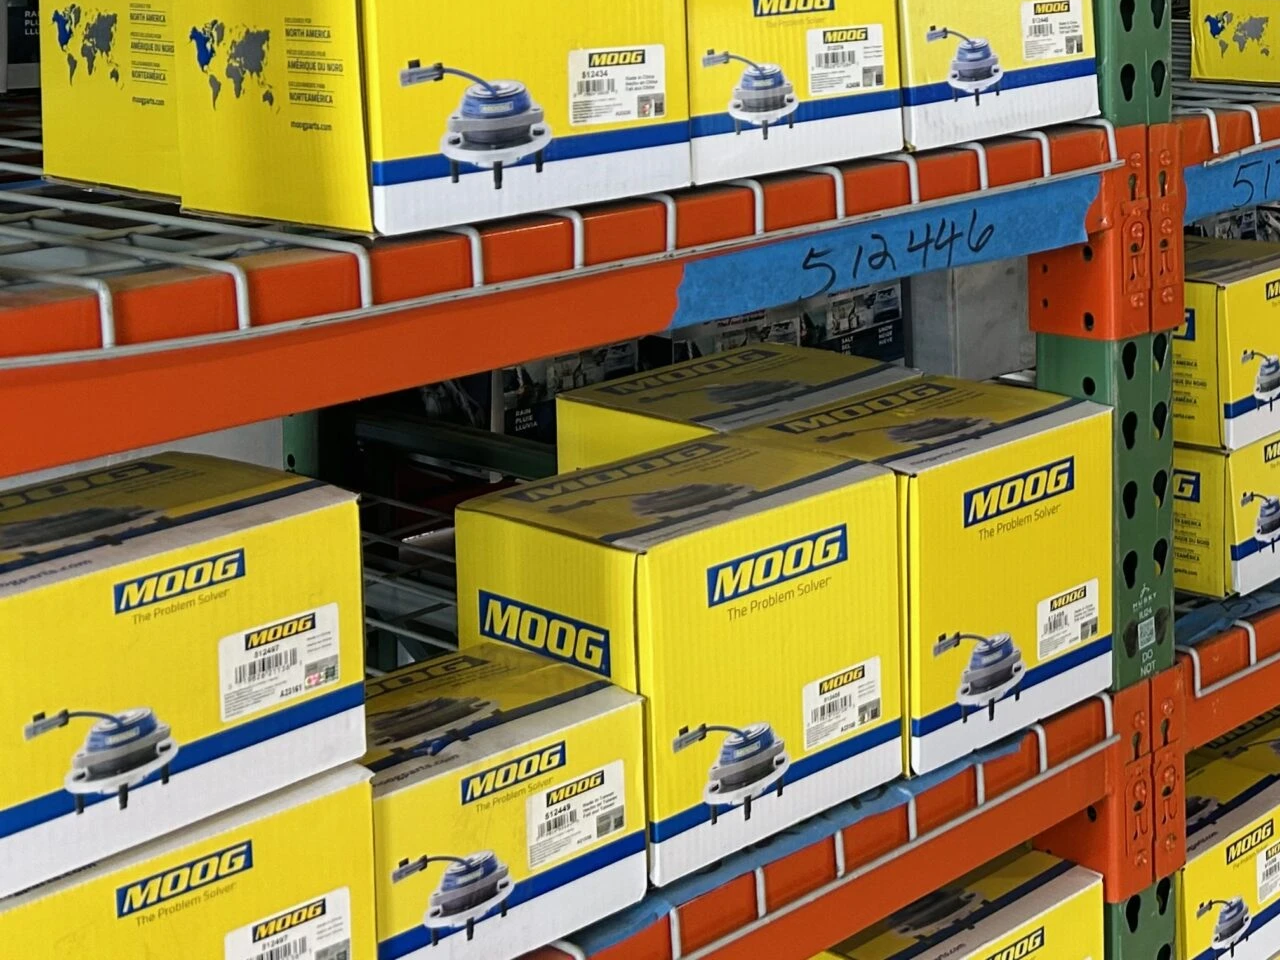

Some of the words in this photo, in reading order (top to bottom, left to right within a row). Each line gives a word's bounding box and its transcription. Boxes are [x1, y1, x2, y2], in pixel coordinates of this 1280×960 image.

[130, 13, 145, 21] NORTH
[146, 14, 166, 23] AMERICA
[1036, 2, 1068, 14] MOOG
[285, 29, 303, 38] NORTH
[305, 29, 331, 38] AMERICA
[824, 29, 866, 42] MOOG
[591, 51, 642, 66] MOOG
[799, 209, 994, 299] 512446
[968, 462, 1072, 524] MOOG
[979, 526, 994, 540] The
[997, 515, 1032, 534] Problem
[1034, 504, 1059, 522] Solver
[120, 554, 241, 610] MOOG
[713, 529, 842, 602] MOOG
[133, 612, 151, 624] The
[154, 600, 196, 619] Problem
[198, 590, 228, 605] Solver
[728, 607, 748, 621] The
[750, 590, 795, 613] Problem
[798, 578, 829, 597] Solver
[1052, 590, 1085, 609] MOOG
[248, 615, 313, 648] MOOG
[484, 600, 604, 668] MOOG
[1141, 660, 1156, 676] NOT
[1142, 649, 1153, 662] DO
[821, 667, 863, 693] MOOG
[465, 746, 562, 801] MOOG
[549, 773, 601, 805] MOOG
[476, 801, 491, 813] The
[492, 788, 527, 808] Problem
[528, 778, 552, 794] Solver
[1227, 822, 1272, 862] MOOG
[123, 844, 248, 914] MOOG
[137, 915, 156, 926] The
[158, 895, 202, 920] Problem
[204, 884, 234, 903] Solver
[256, 901, 322, 940] MOOG
